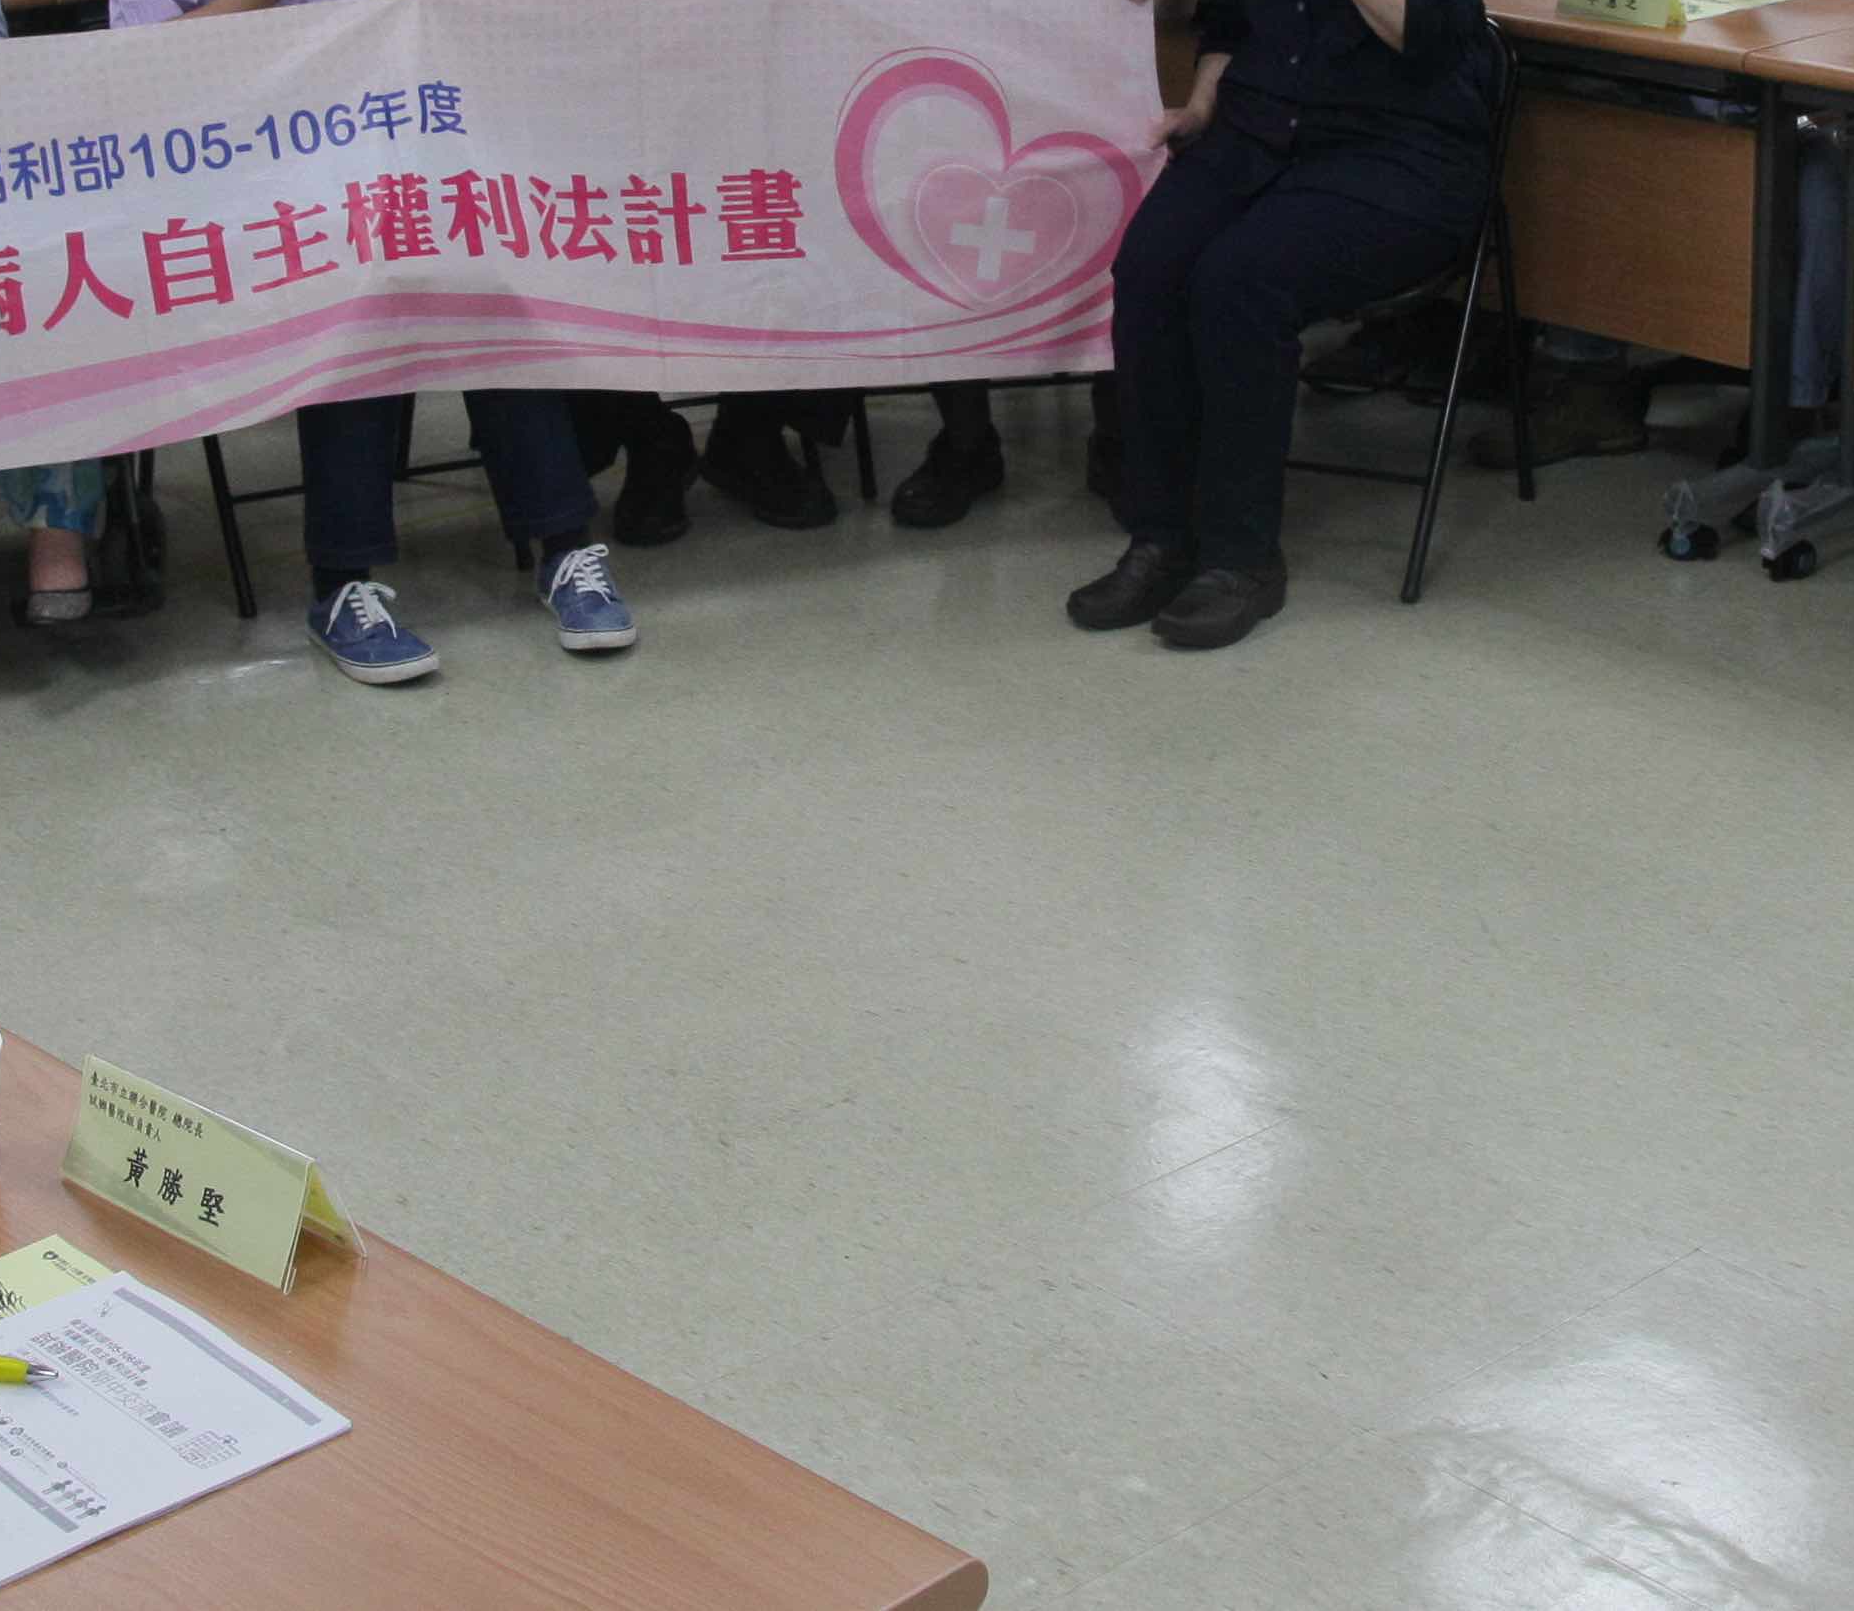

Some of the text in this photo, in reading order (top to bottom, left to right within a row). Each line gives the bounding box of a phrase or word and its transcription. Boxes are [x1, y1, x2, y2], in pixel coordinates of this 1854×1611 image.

[89, 1070, 205, 1140] 臺北市立聯合醫院 總院長
[123, 1147, 226, 1227] 黃勝堅
